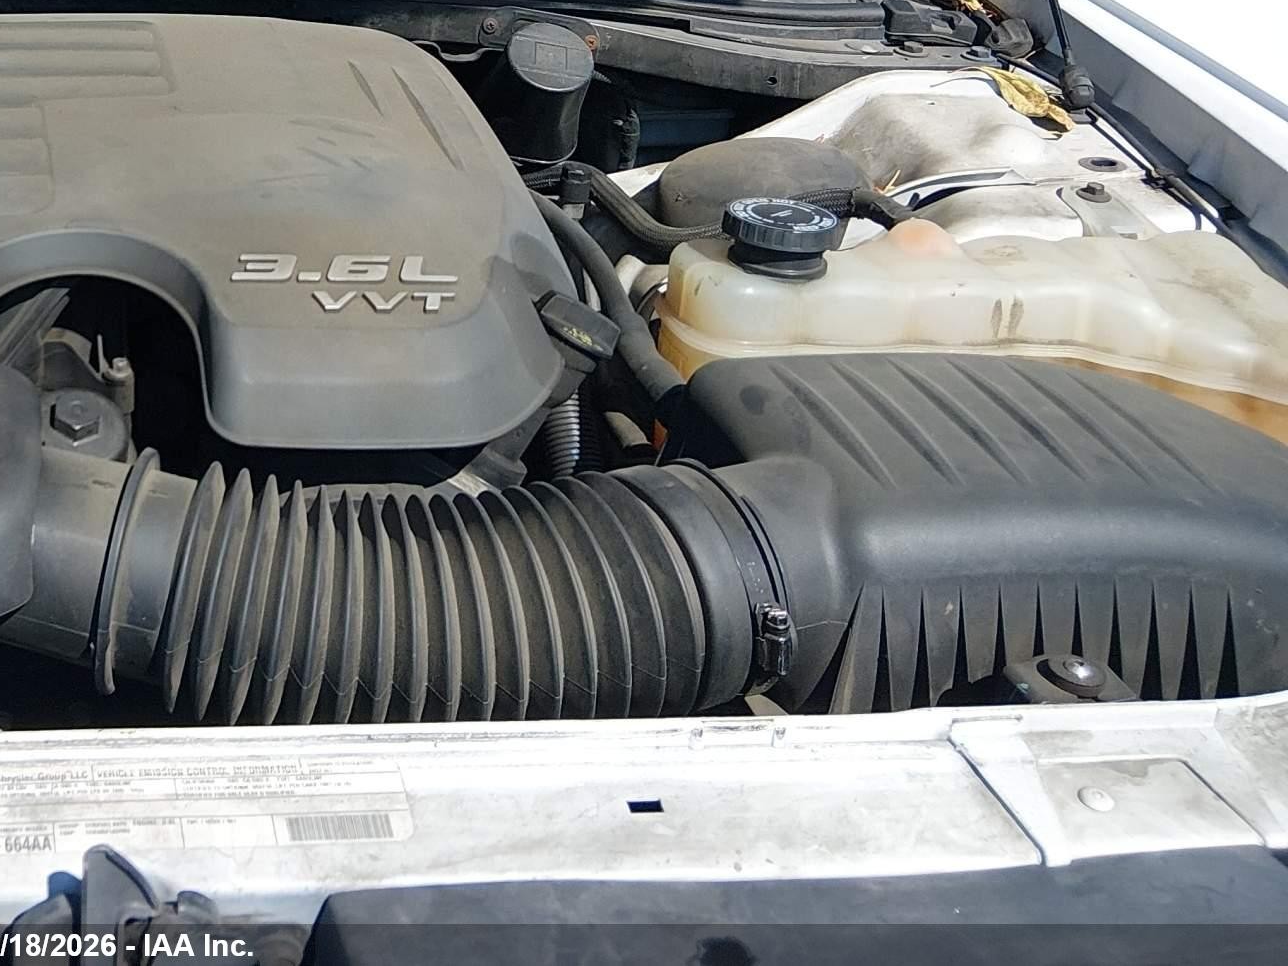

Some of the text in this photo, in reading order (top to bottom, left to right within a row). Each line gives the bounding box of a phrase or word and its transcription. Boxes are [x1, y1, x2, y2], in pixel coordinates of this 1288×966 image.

[230, 254, 459, 282] 3.6L
[312, 290, 456, 313] VVT
[37, 771, 66, 783] Group
[70, 770, 88, 779] LLC
[97, 769, 134, 778] VEHICLE
[139, 768, 184, 777] EMISSION
[187, 766, 230, 776] CONTROL
[233, 764, 299, 775] INFORMATION
[5, 835, 52, 853] 664AA
